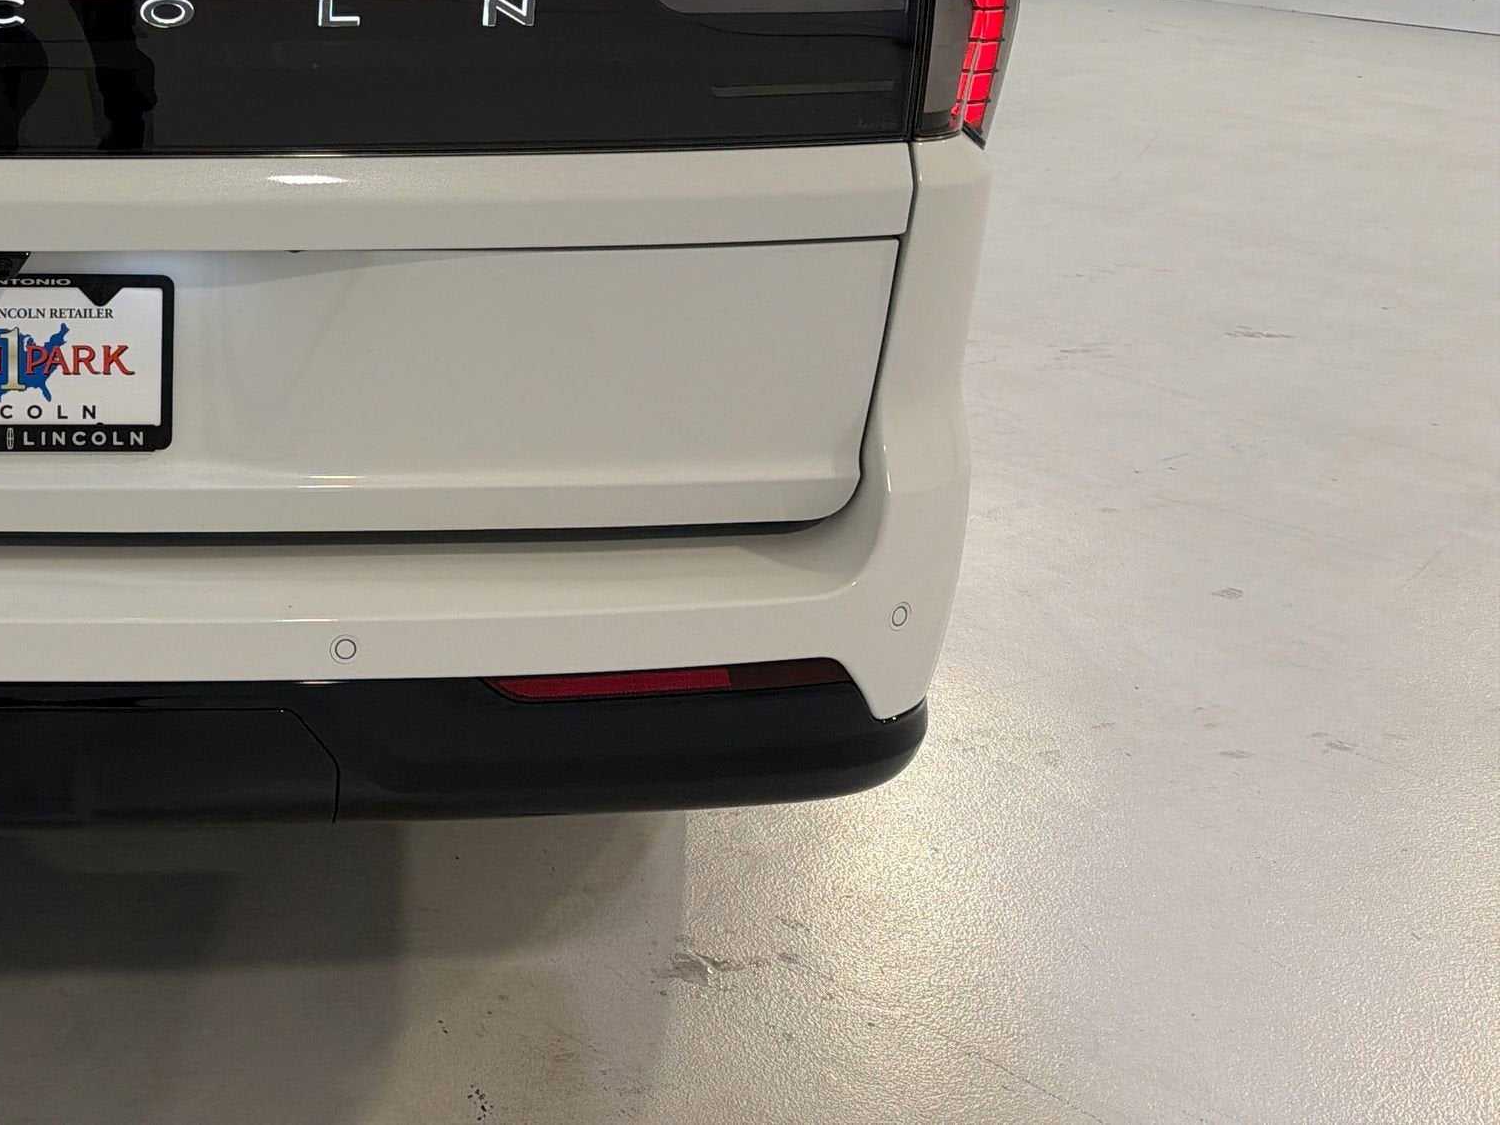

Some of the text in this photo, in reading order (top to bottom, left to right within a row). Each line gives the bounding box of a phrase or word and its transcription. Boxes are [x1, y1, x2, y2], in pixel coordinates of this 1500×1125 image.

[49, 307, 114, 319] RETAILER
[25, 344, 136, 375] PARK
[22, 431, 144, 446] LINCOLN
